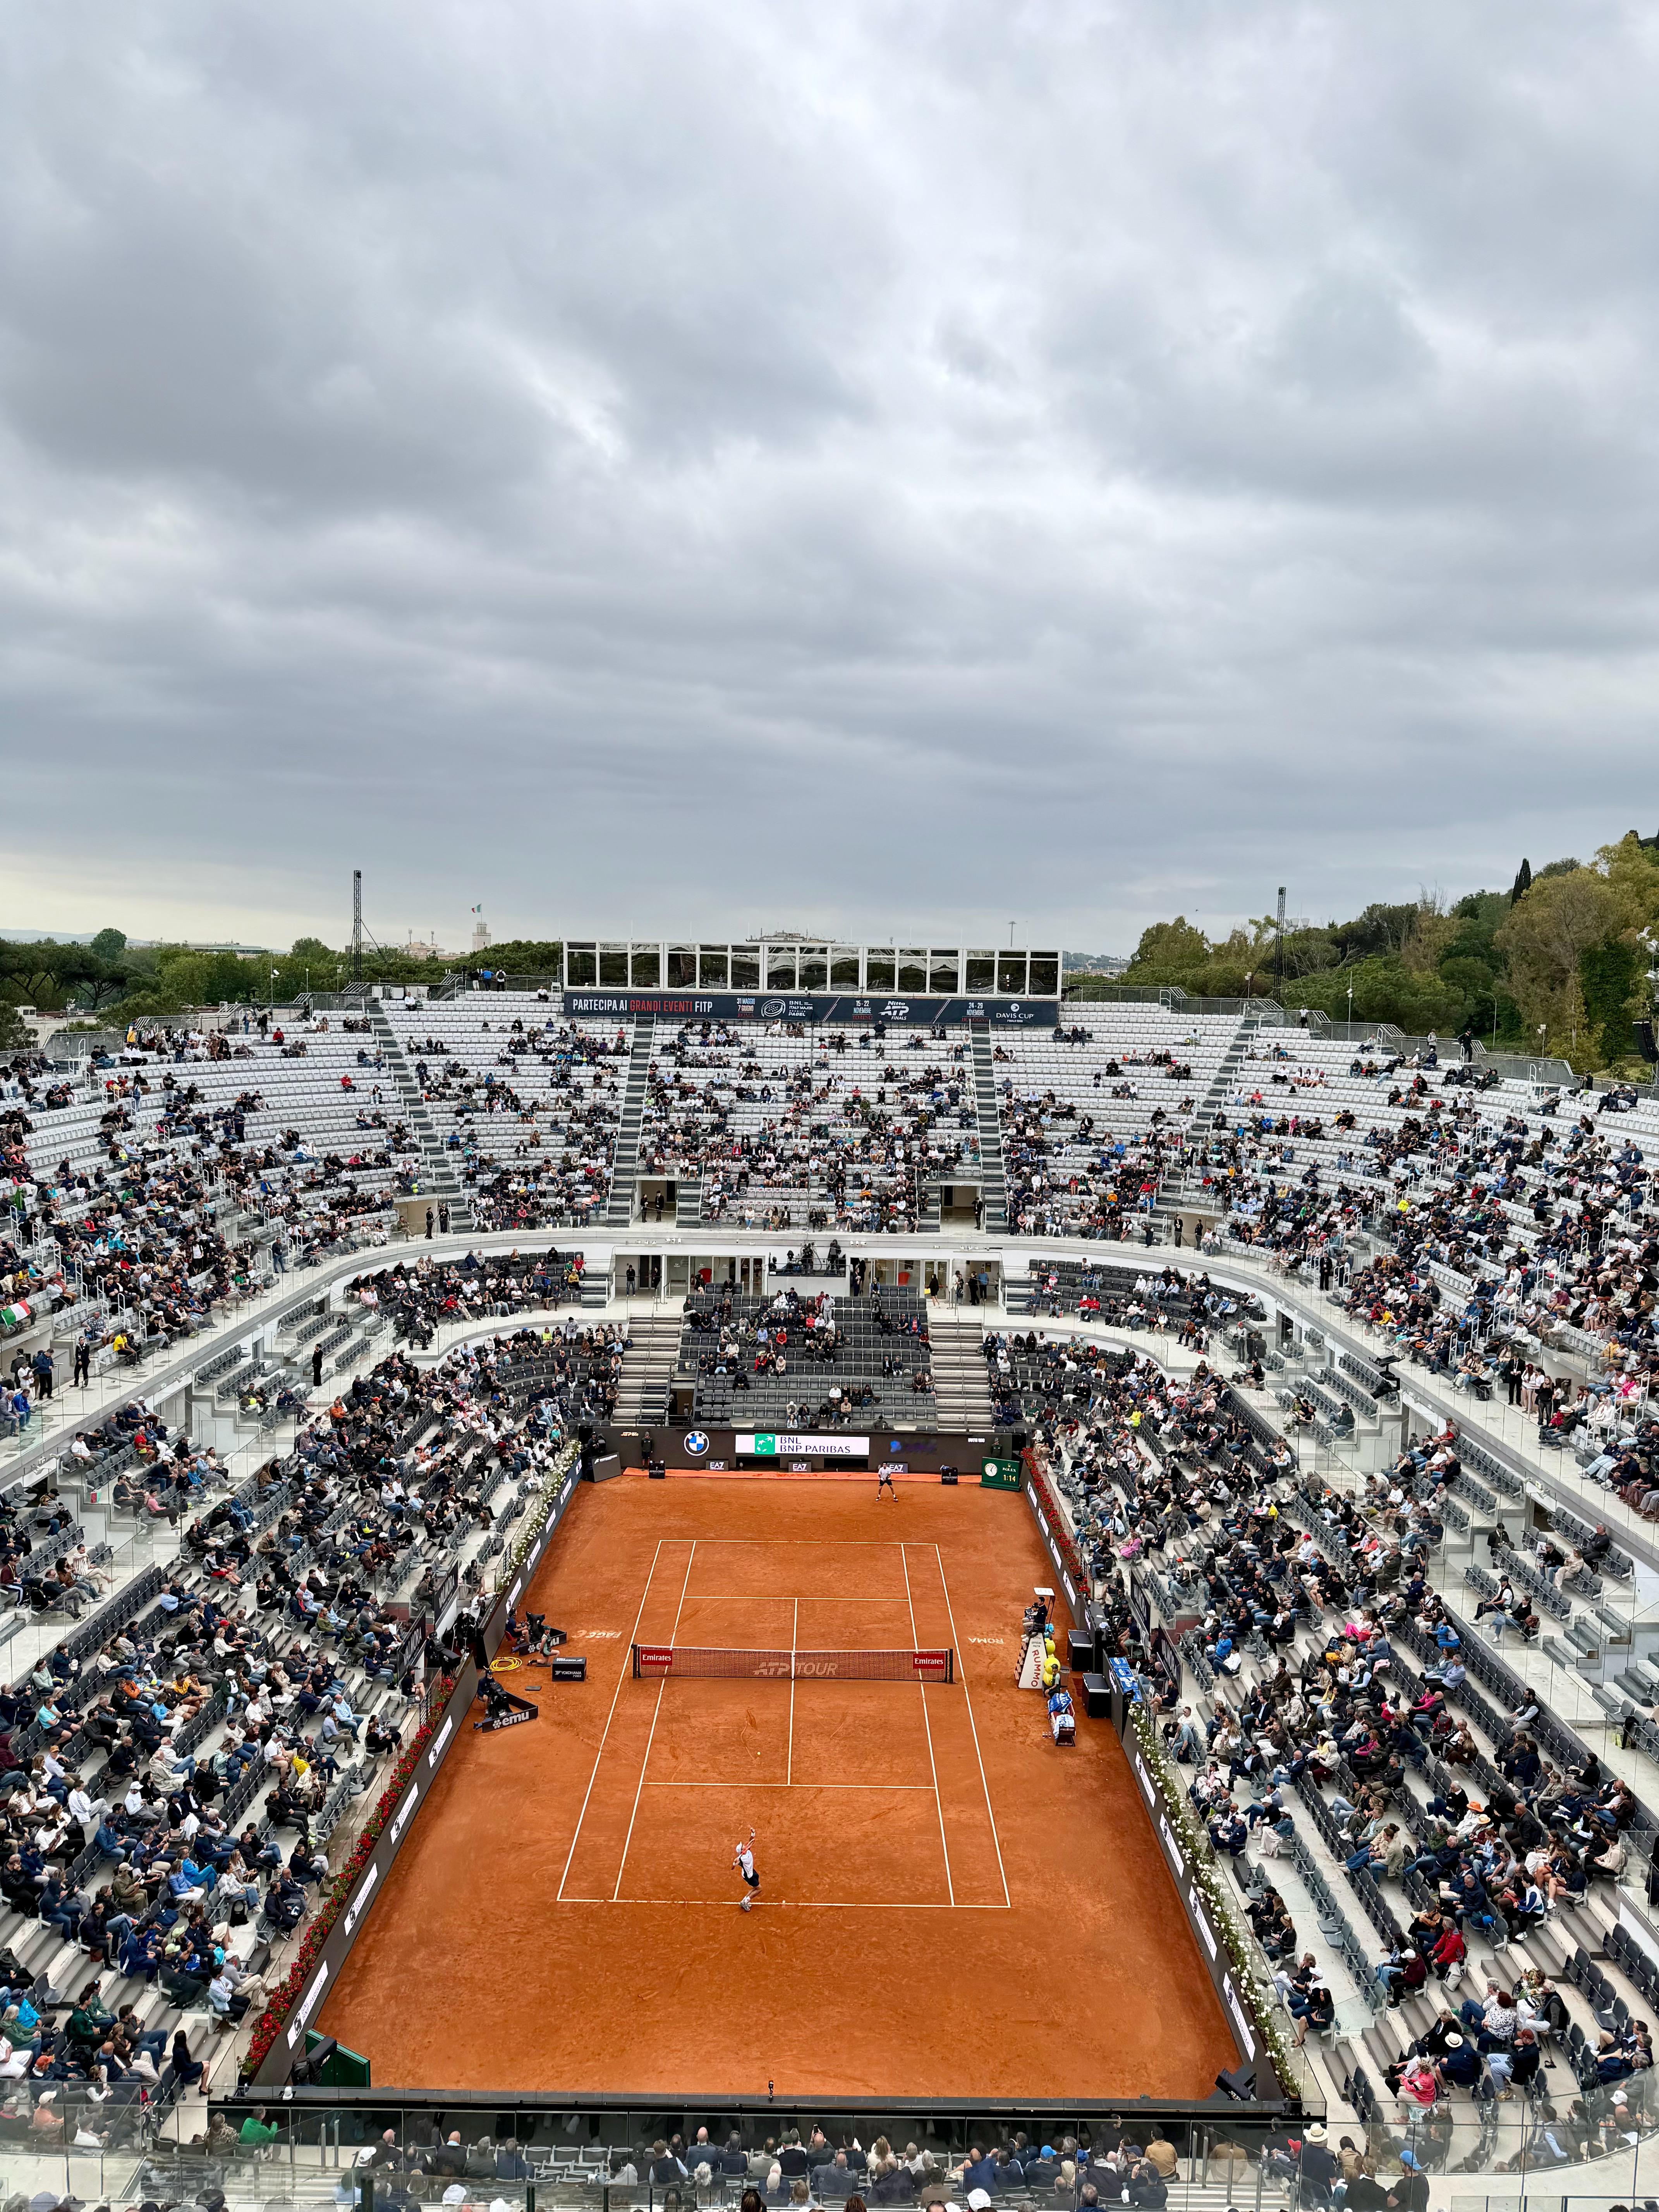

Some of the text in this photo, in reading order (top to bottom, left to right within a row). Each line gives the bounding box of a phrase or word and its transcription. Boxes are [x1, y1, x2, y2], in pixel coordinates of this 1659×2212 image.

[573, 998, 713, 1013] PARTECIPA AI GRANDI EVENTI FITP
[878, 1005, 909, 1016] ATP
[805, 1445, 850, 1453] PARIBAS
[536, 1637, 560, 1650] eu
[753, 1662, 838, 1675] ATP TOUR
[1031, 1649, 1041, 1687] RUMMO
[502, 1711, 529, 1726] emu
